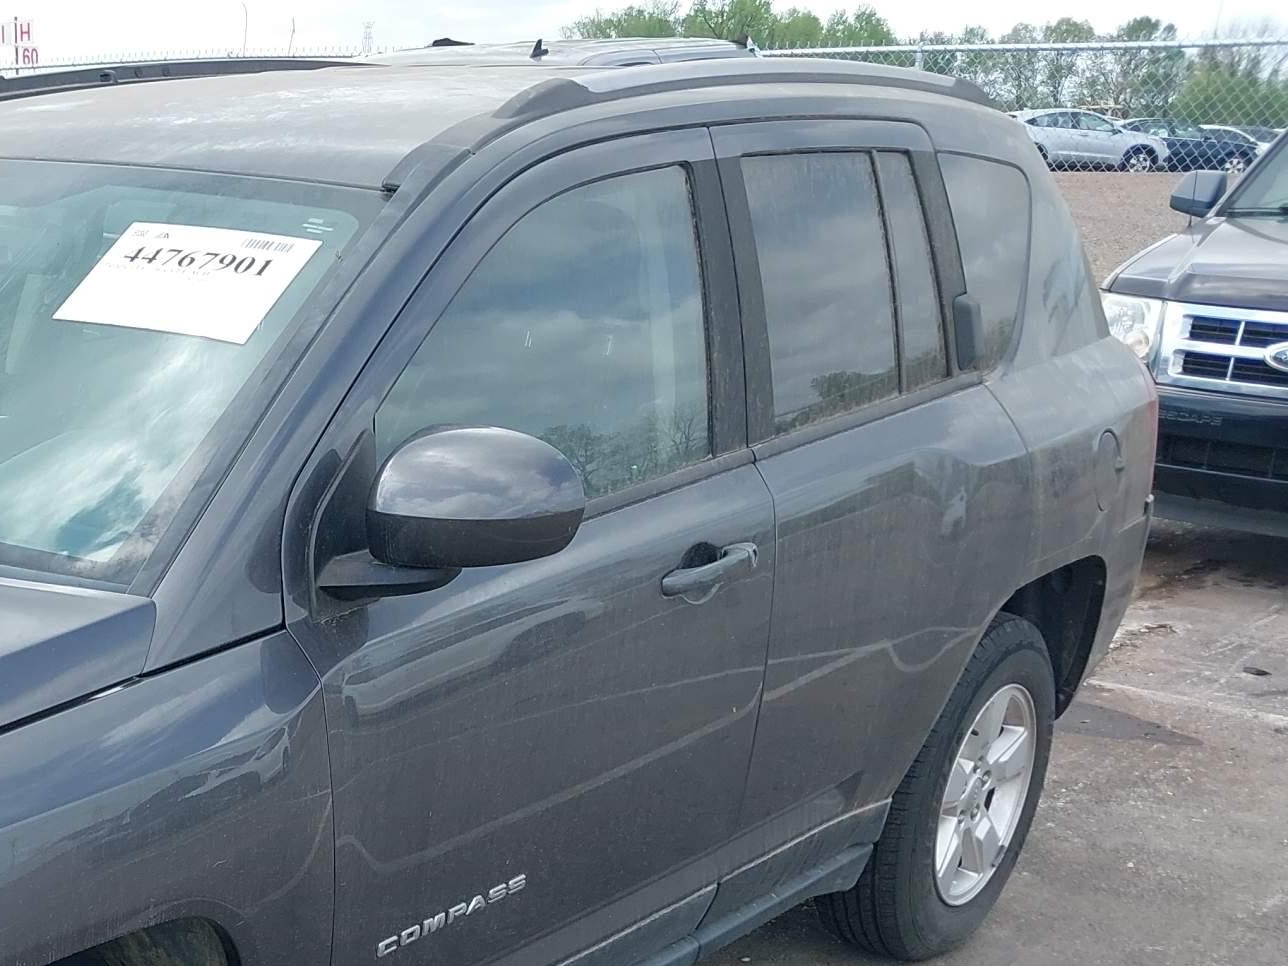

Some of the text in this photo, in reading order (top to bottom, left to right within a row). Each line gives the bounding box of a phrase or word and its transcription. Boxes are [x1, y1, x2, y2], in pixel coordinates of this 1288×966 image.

[19, 22, 31, 42] H
[22, 47, 39, 65] 60
[123, 245, 274, 277] 44767901
[376, 873, 527, 958] COMPASS
